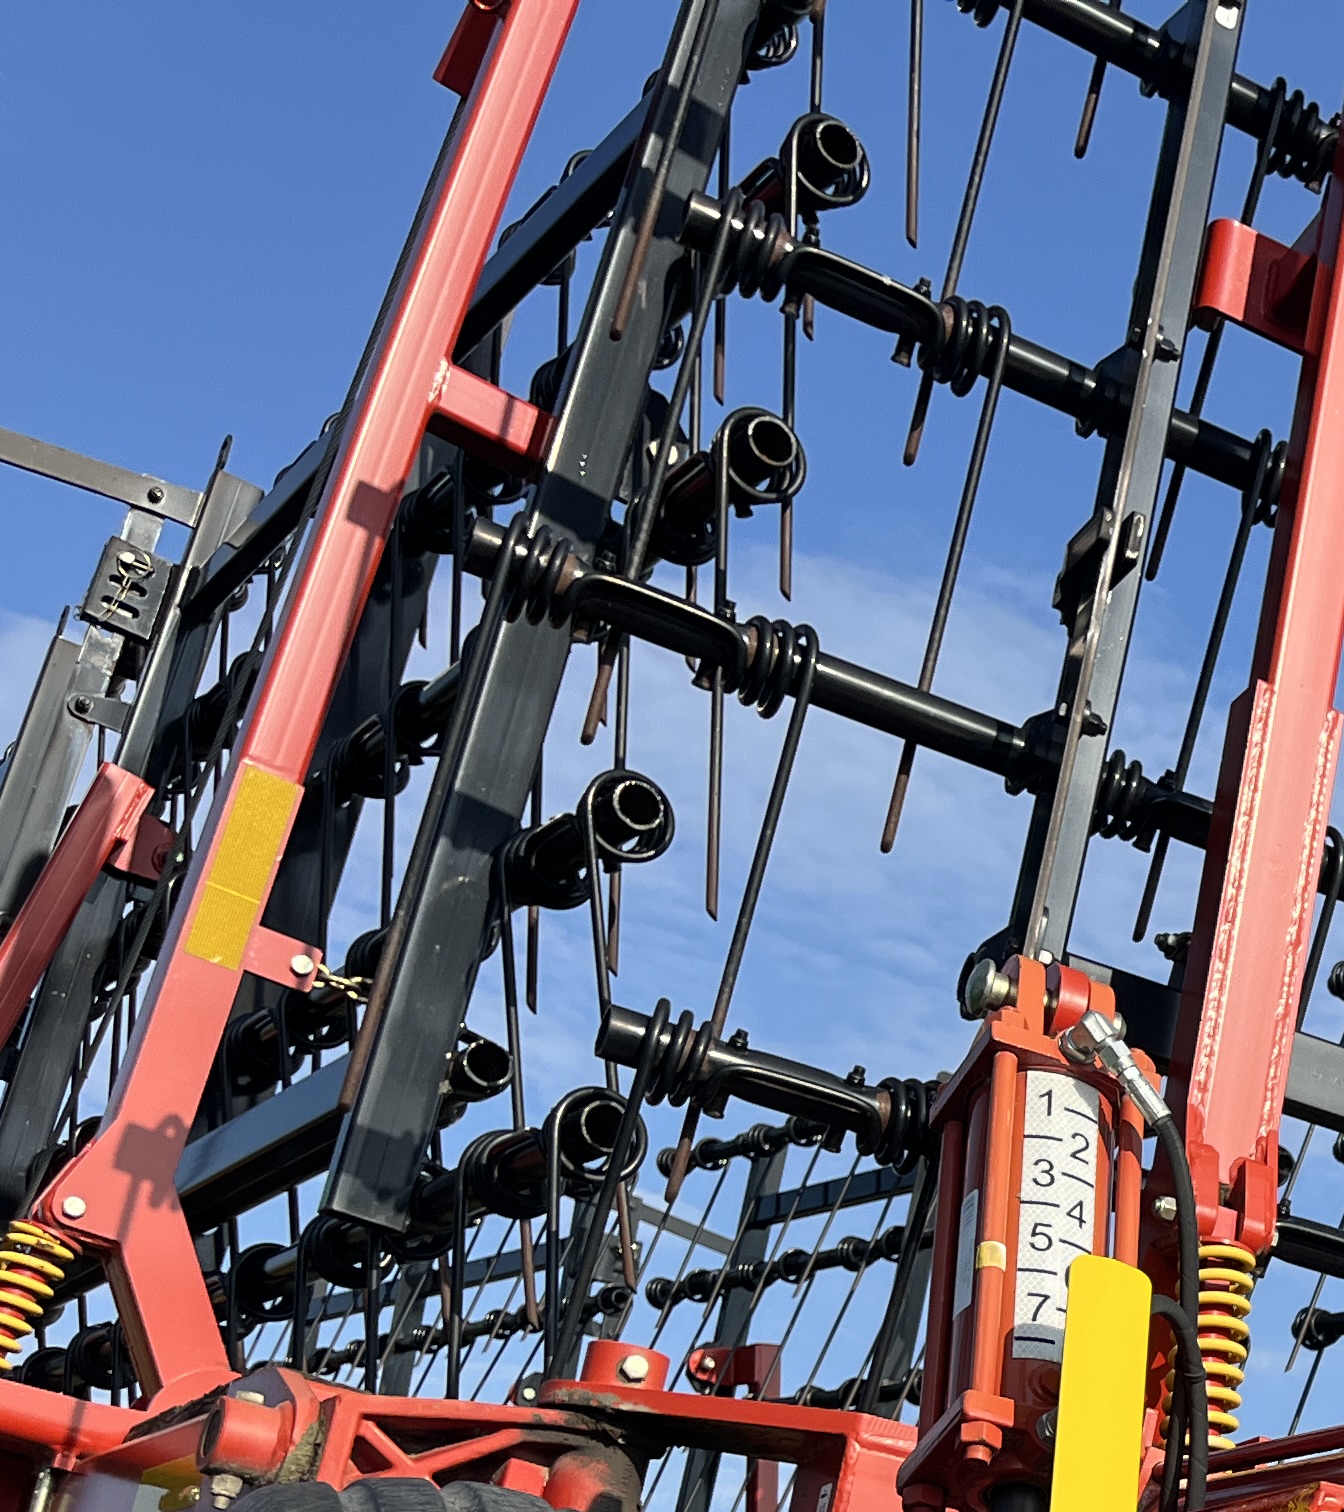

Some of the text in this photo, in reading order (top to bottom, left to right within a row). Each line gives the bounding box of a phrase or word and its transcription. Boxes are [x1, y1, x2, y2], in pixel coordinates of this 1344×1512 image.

[1038, 1088, 1053, 1117] 1
[1070, 1132, 1090, 1165] 2
[1032, 1158, 1056, 1187] 3
[1066, 1200, 1087, 1228] 4
[1029, 1223, 1053, 1251] 5
[1027, 1293, 1051, 1322] 7
